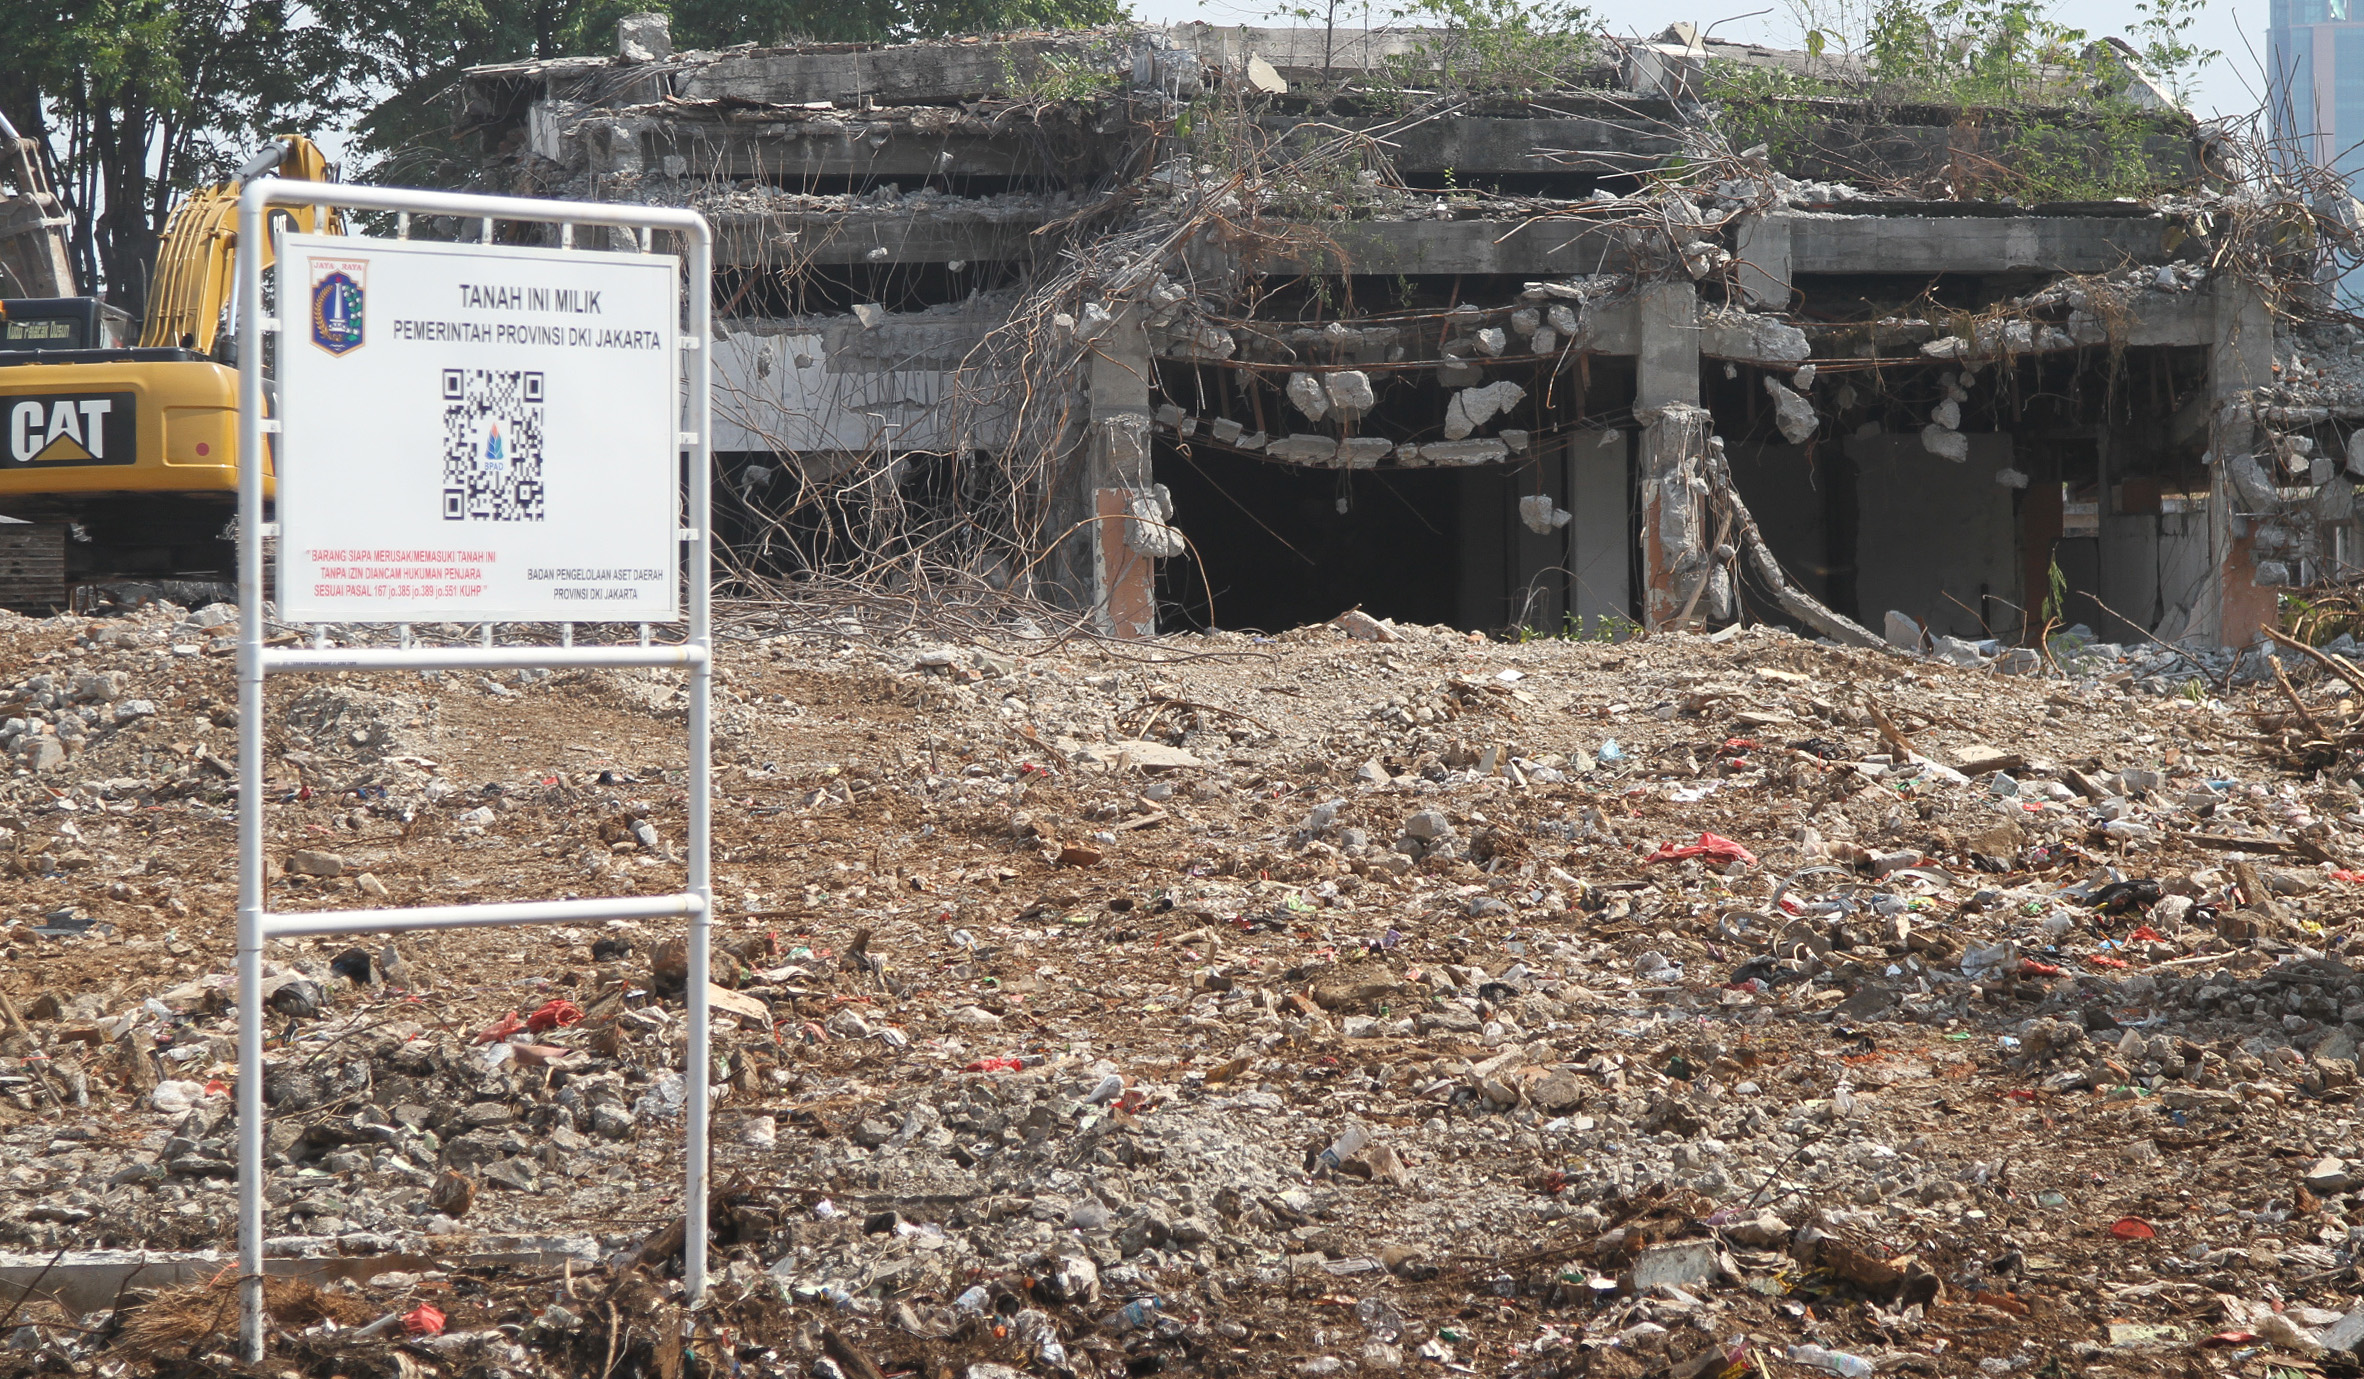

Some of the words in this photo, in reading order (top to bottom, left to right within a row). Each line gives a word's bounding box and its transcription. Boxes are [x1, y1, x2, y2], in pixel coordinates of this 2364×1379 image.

[342, 263, 362, 271] RAYA
[459, 284, 522, 310] TANAH
[528, 288, 549, 312] INI
[555, 289, 601, 314] MILIK
[393, 320, 491, 342] PEMERINTAH
[496, 324, 564, 346] PROVINSI
[569, 327, 591, 347] DKI
[595, 329, 661, 350] JAKARTA
[11, 399, 112, 462] CAT
[485, 462, 504, 471] BPAD
[312, 550, 346, 562] BARANG
[348, 550, 371, 562] SIAPA
[374, 550, 455, 562] MERUSAK/MEMASUKI
[457, 551, 483, 563] TANAH
[485, 551, 496, 563] INI
[321, 567, 346, 579] TANPA
[349, 567, 363, 579] IZIN
[366, 568, 401, 579] DIANCAM
[404, 568, 442, 580] HUKUMAN
[444, 568, 481, 580] PENJARA
[528, 569, 554, 580] BADAN
[556, 569, 611, 580] PENGELOLAAN
[613, 569, 632, 581] ASET
[634, 569, 663, 581] DAERAH
[314, 585, 344, 596] SESUAI
[346, 585, 371, 596] PASAL
[374, 585, 386, 596] 167
[388, 585, 410, 599] jo.385
[412, 585, 434, 599] jo.389
[436, 585, 457, 599] jo.551
[460, 585, 481, 597] KUHP
[554, 589, 589, 600] PROVINSI
[590, 589, 602, 600] DKI
[604, 589, 637, 600] JAKARTA
